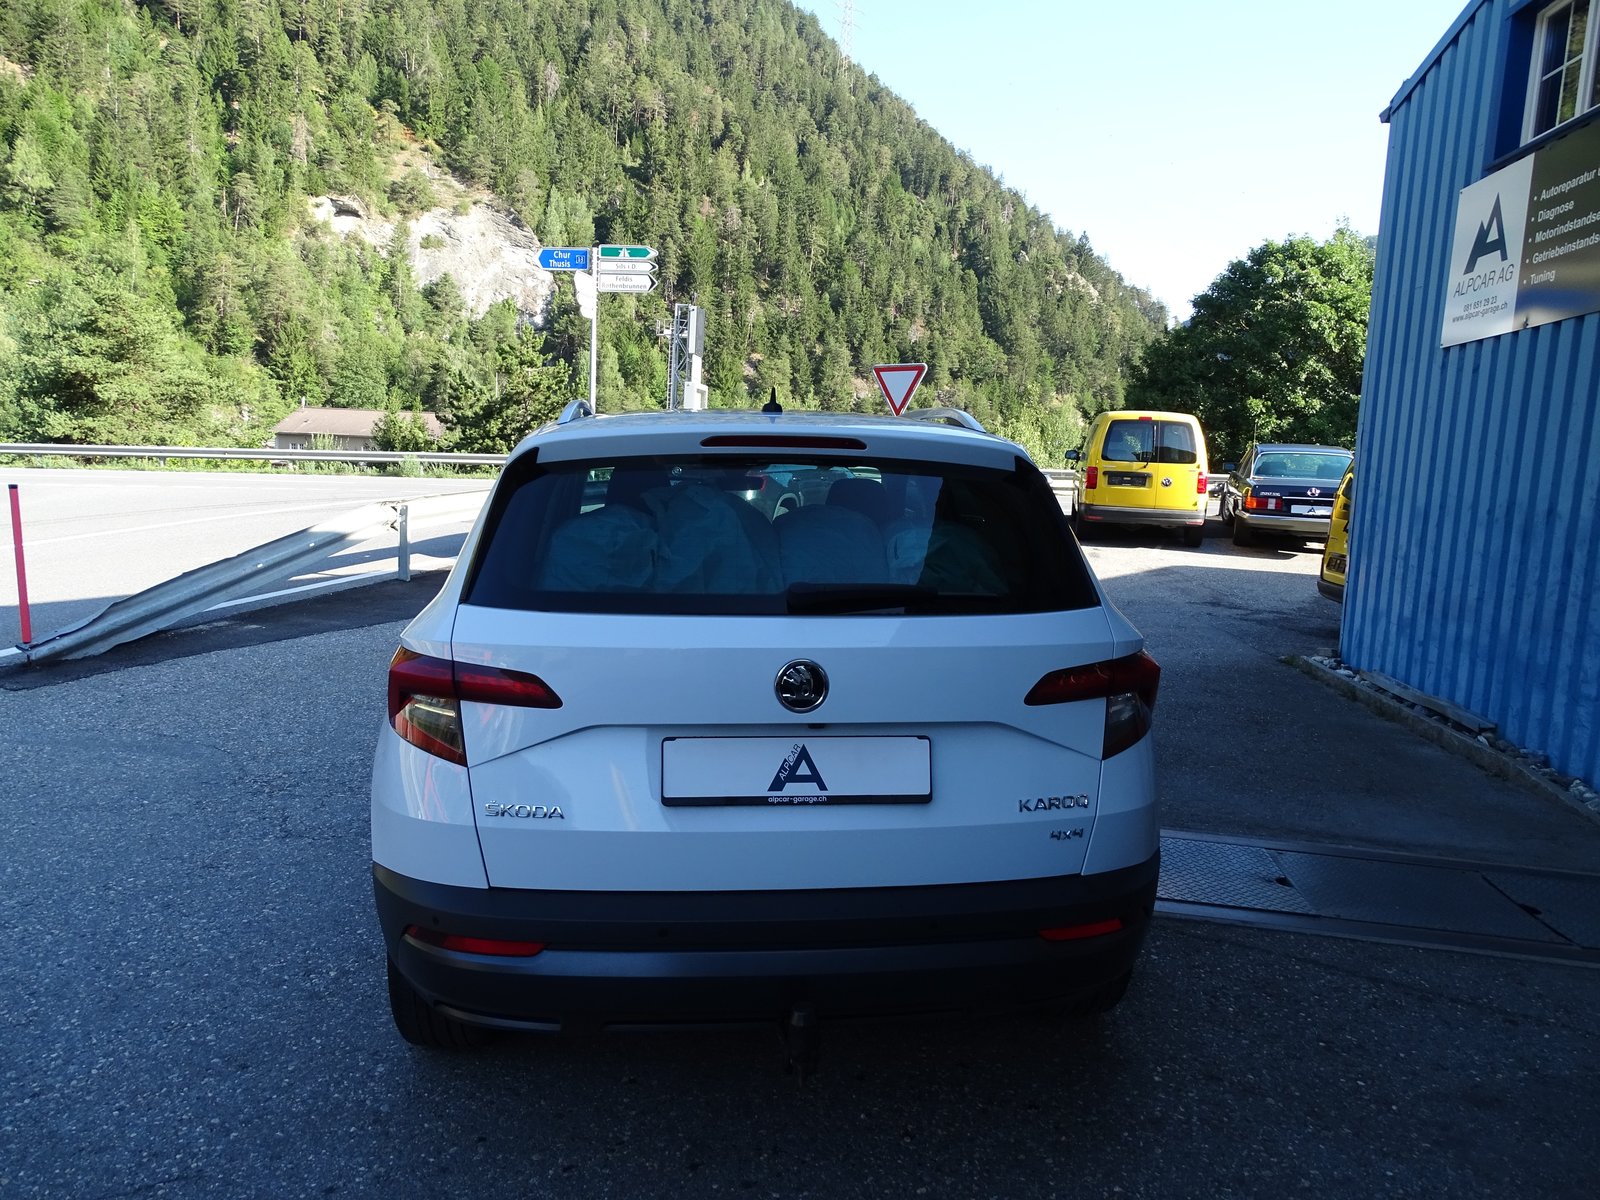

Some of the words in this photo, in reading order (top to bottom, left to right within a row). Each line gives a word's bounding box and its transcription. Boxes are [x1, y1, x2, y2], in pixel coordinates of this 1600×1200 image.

[1540, 169, 1596, 201] Autoreparatur
[1537, 200, 1574, 222] Diagnose
[553, 251, 571, 259] Chur
[1453, 269, 1496, 298] ALPCAR
[1496, 263, 1515, 284] AG
[1530, 270, 1556, 285] Tuning
[1490, 295, 1498, 305] 23
[1452, 300, 1508, 323] www.alpcar-garage.ch
[779, 743, 801, 781] ALPCAR
[484, 799, 565, 820] ŠKODA
[1018, 794, 1089, 813] KAROQ
